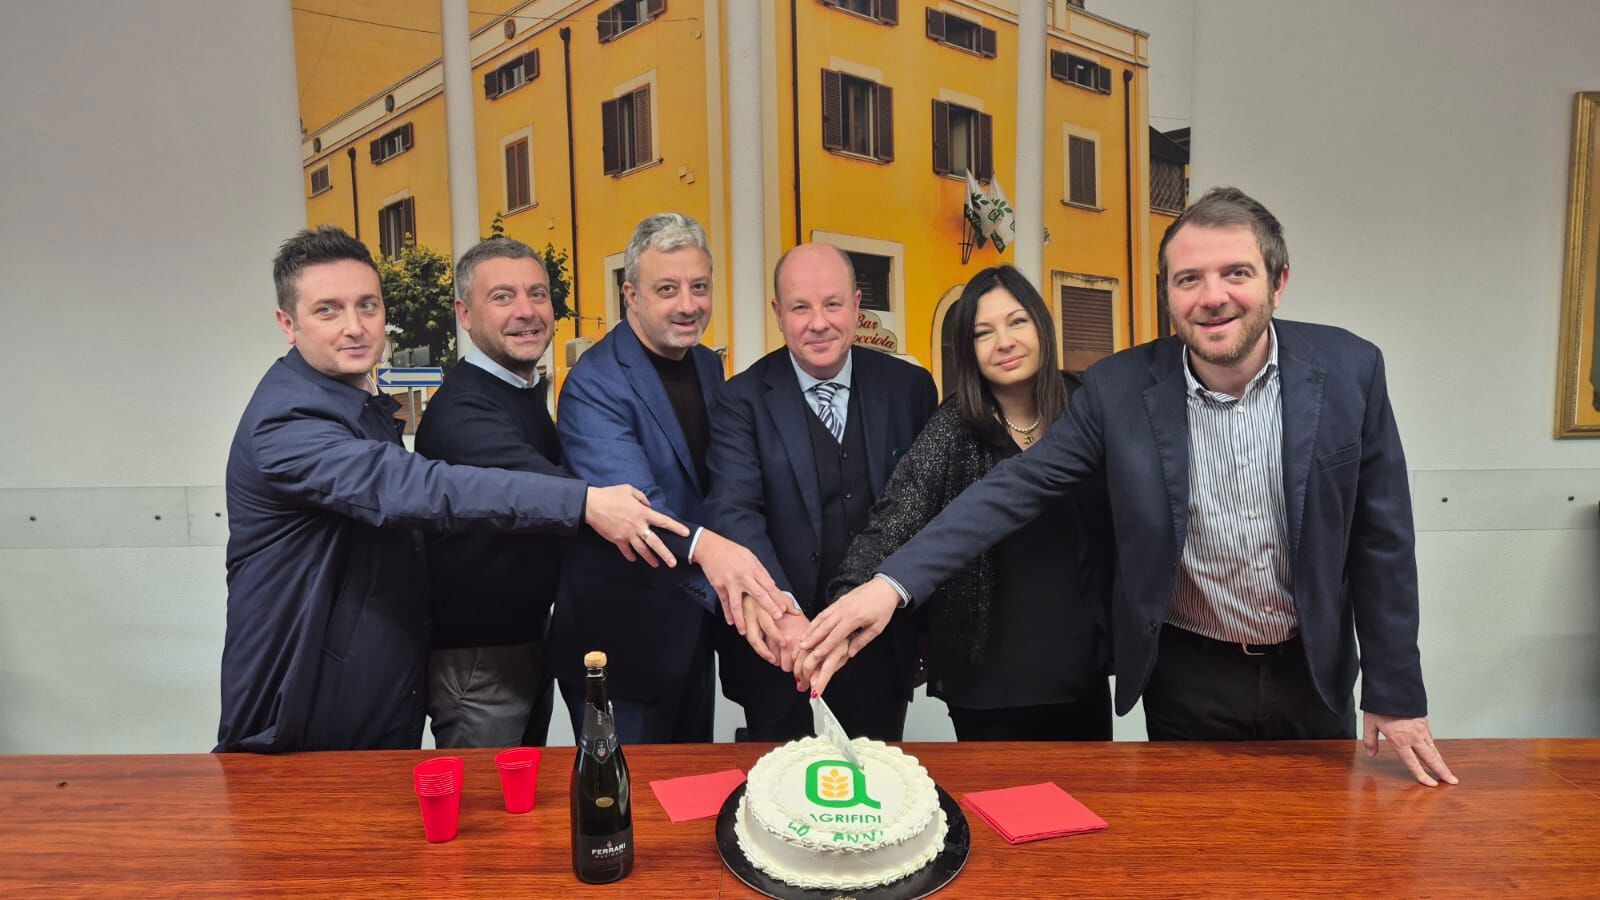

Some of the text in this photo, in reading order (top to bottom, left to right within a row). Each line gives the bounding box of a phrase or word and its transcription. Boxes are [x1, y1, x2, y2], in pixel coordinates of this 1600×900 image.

[856, 312, 878, 329] Bar
[855, 333, 895, 348] occiola
[591, 842, 626, 855] FERRARI
